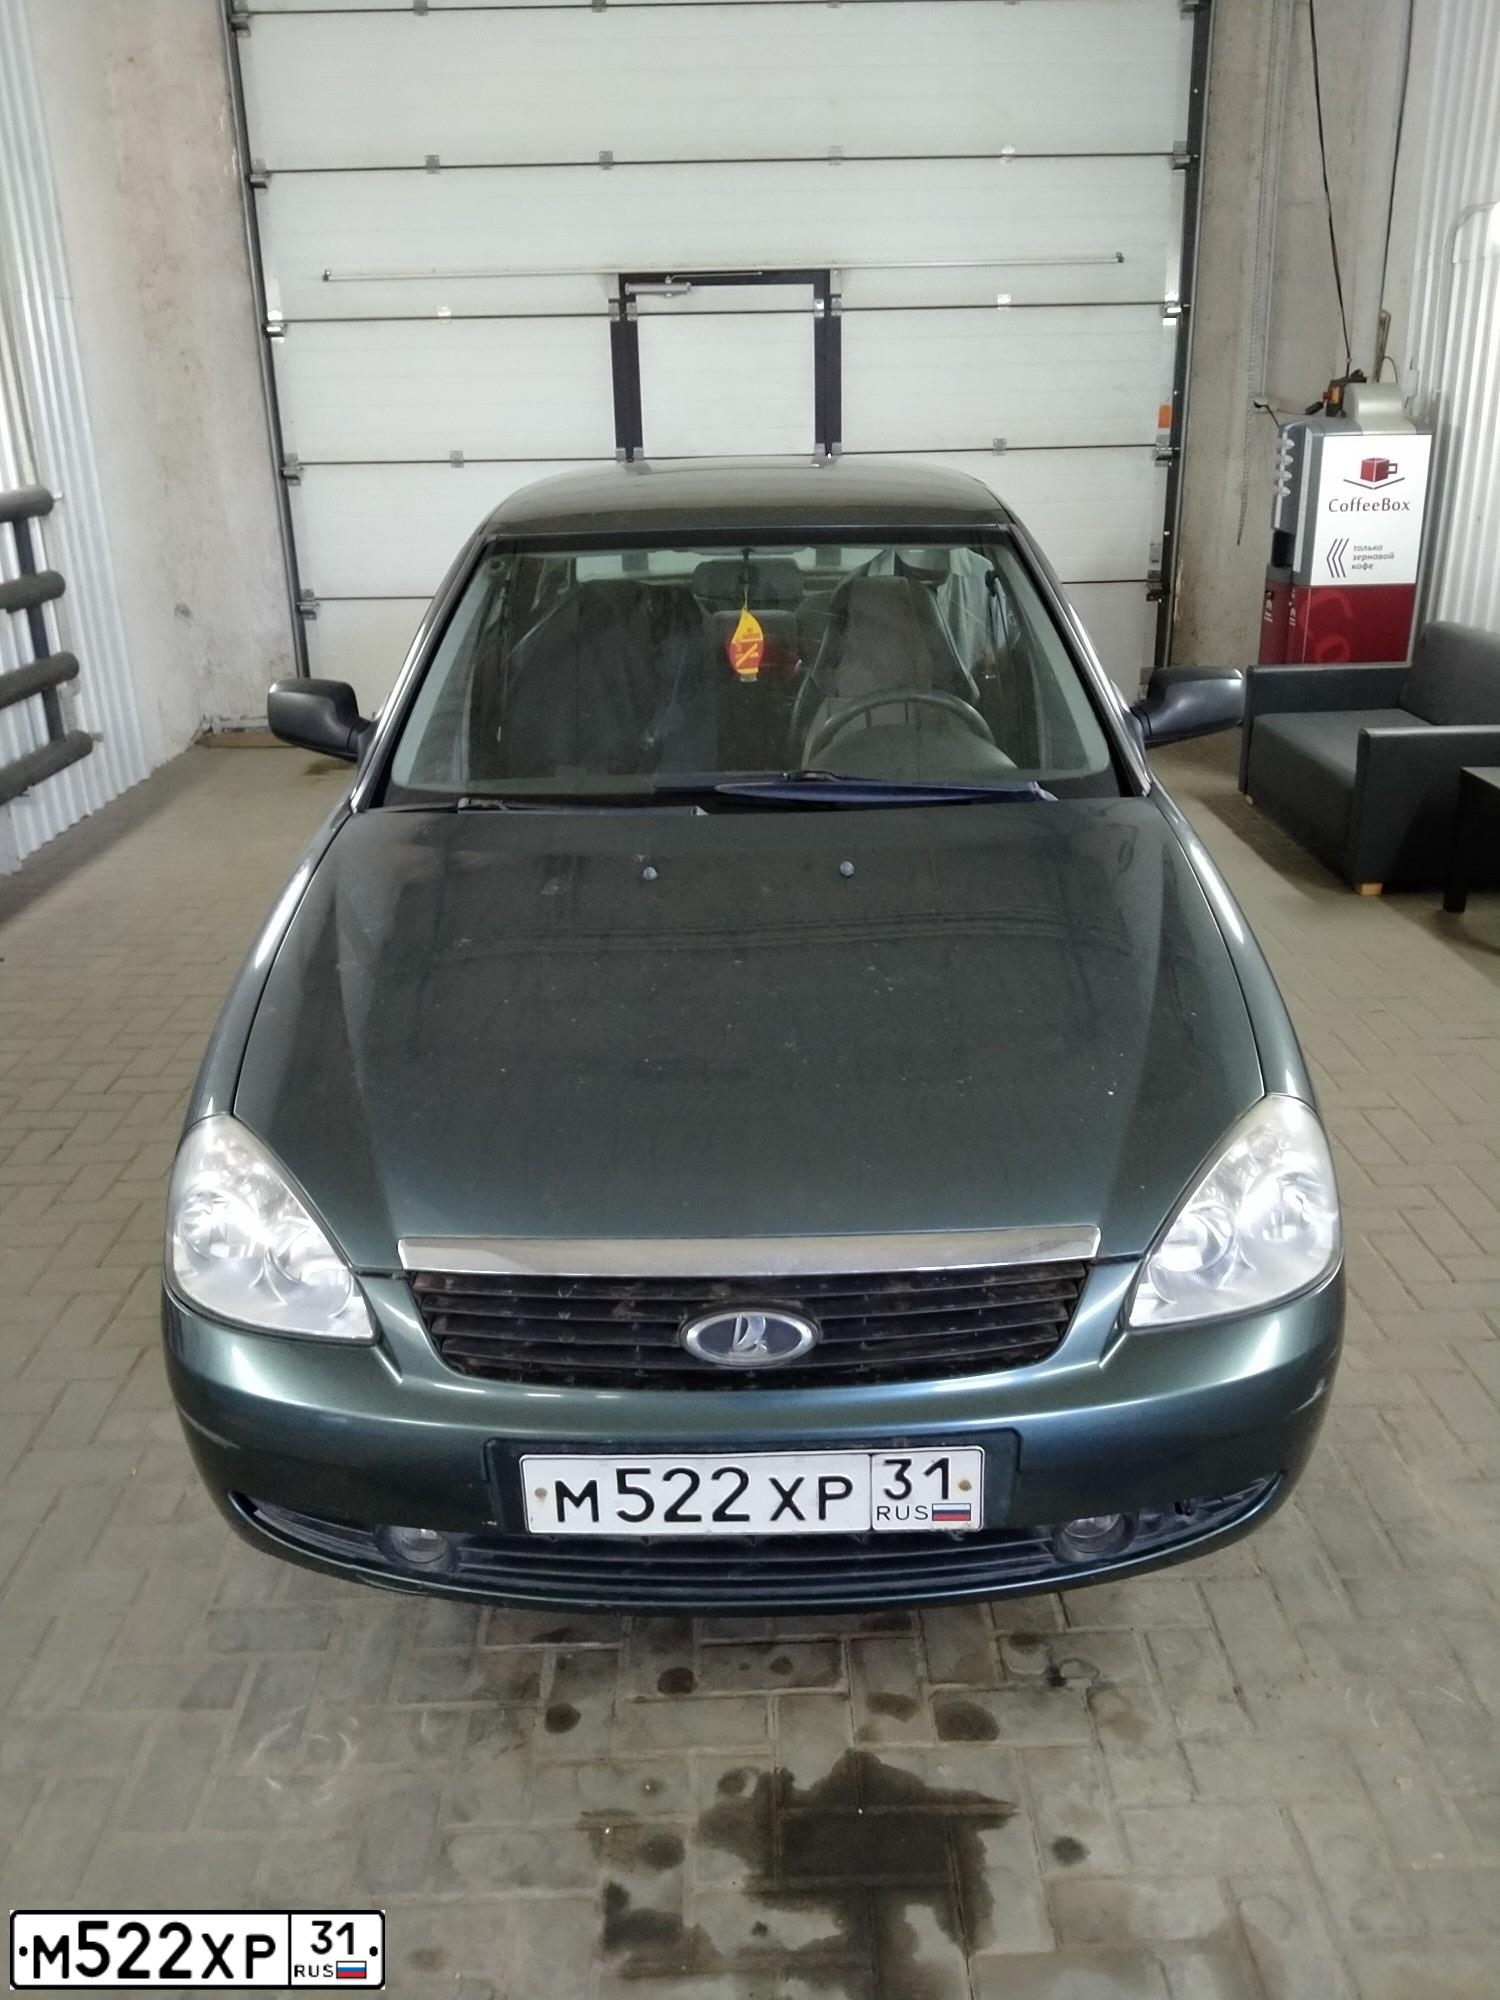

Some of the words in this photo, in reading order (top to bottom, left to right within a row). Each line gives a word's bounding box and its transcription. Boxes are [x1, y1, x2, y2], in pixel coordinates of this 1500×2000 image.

[1328, 497, 1411, 513] CoffeeBox
[1353, 552, 1394, 562] зерновой
[1351, 562, 1375, 571] кофе
[882, 1457, 951, 1501] 31
[876, 1505, 930, 1521] RUS
